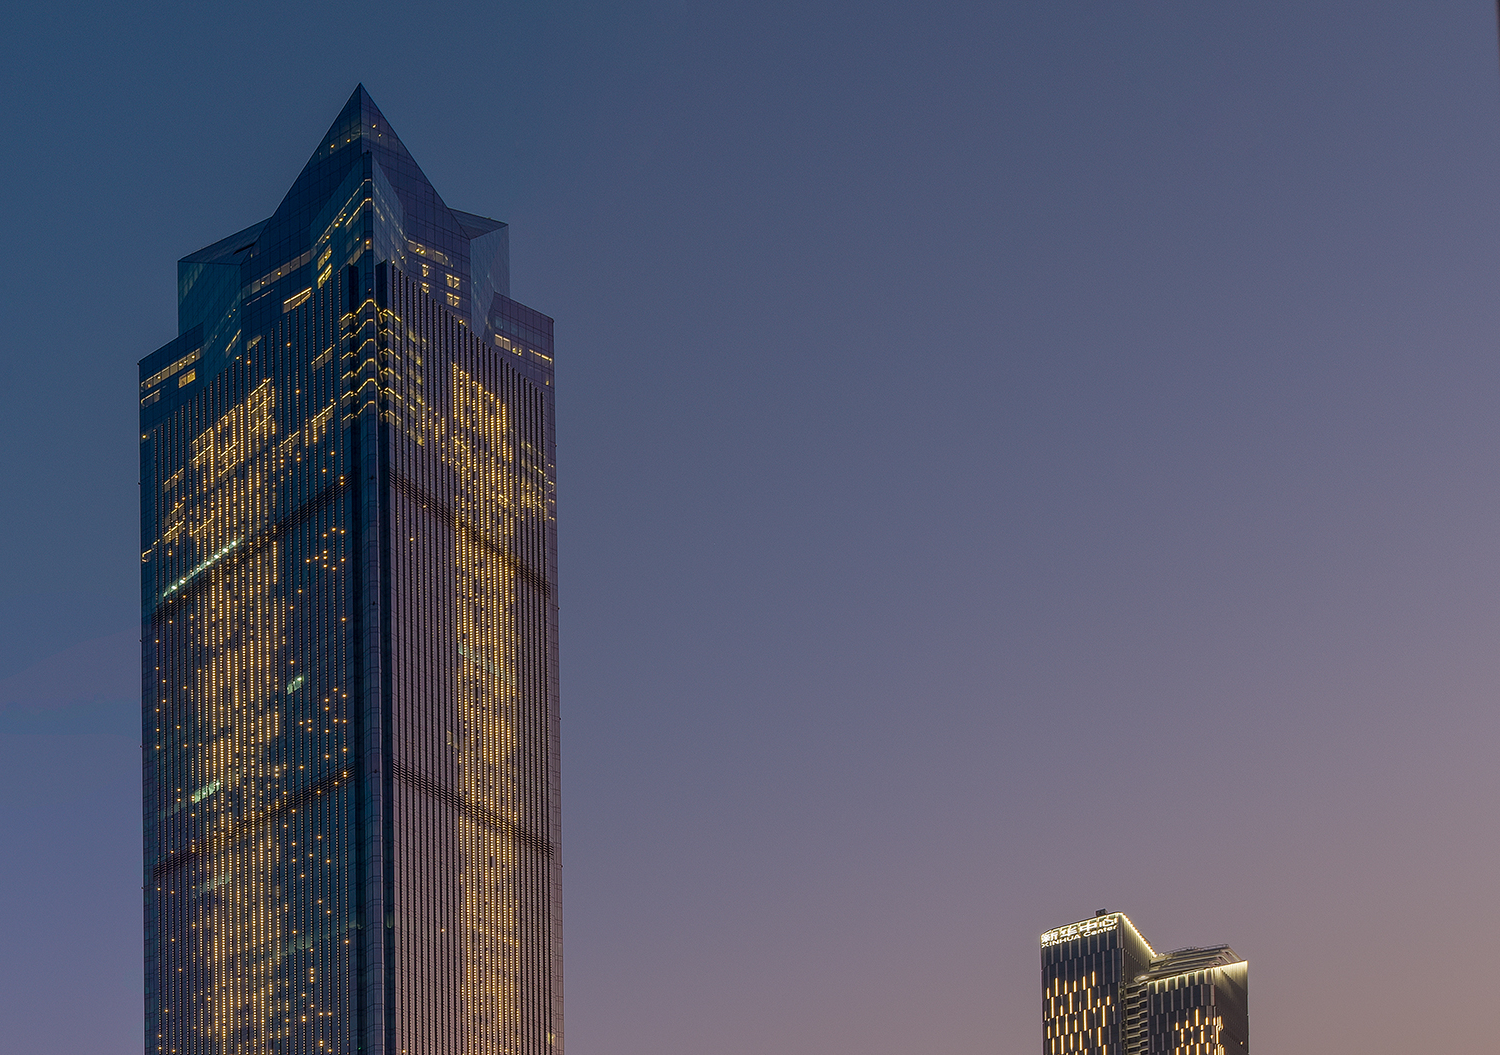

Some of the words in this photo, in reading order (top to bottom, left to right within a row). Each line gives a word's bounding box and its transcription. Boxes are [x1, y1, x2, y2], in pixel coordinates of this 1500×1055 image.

[1041, 917, 1118, 944] 新华中心
[1041, 934, 1081, 949] XINHUA
[1083, 924, 1118, 938] Center
